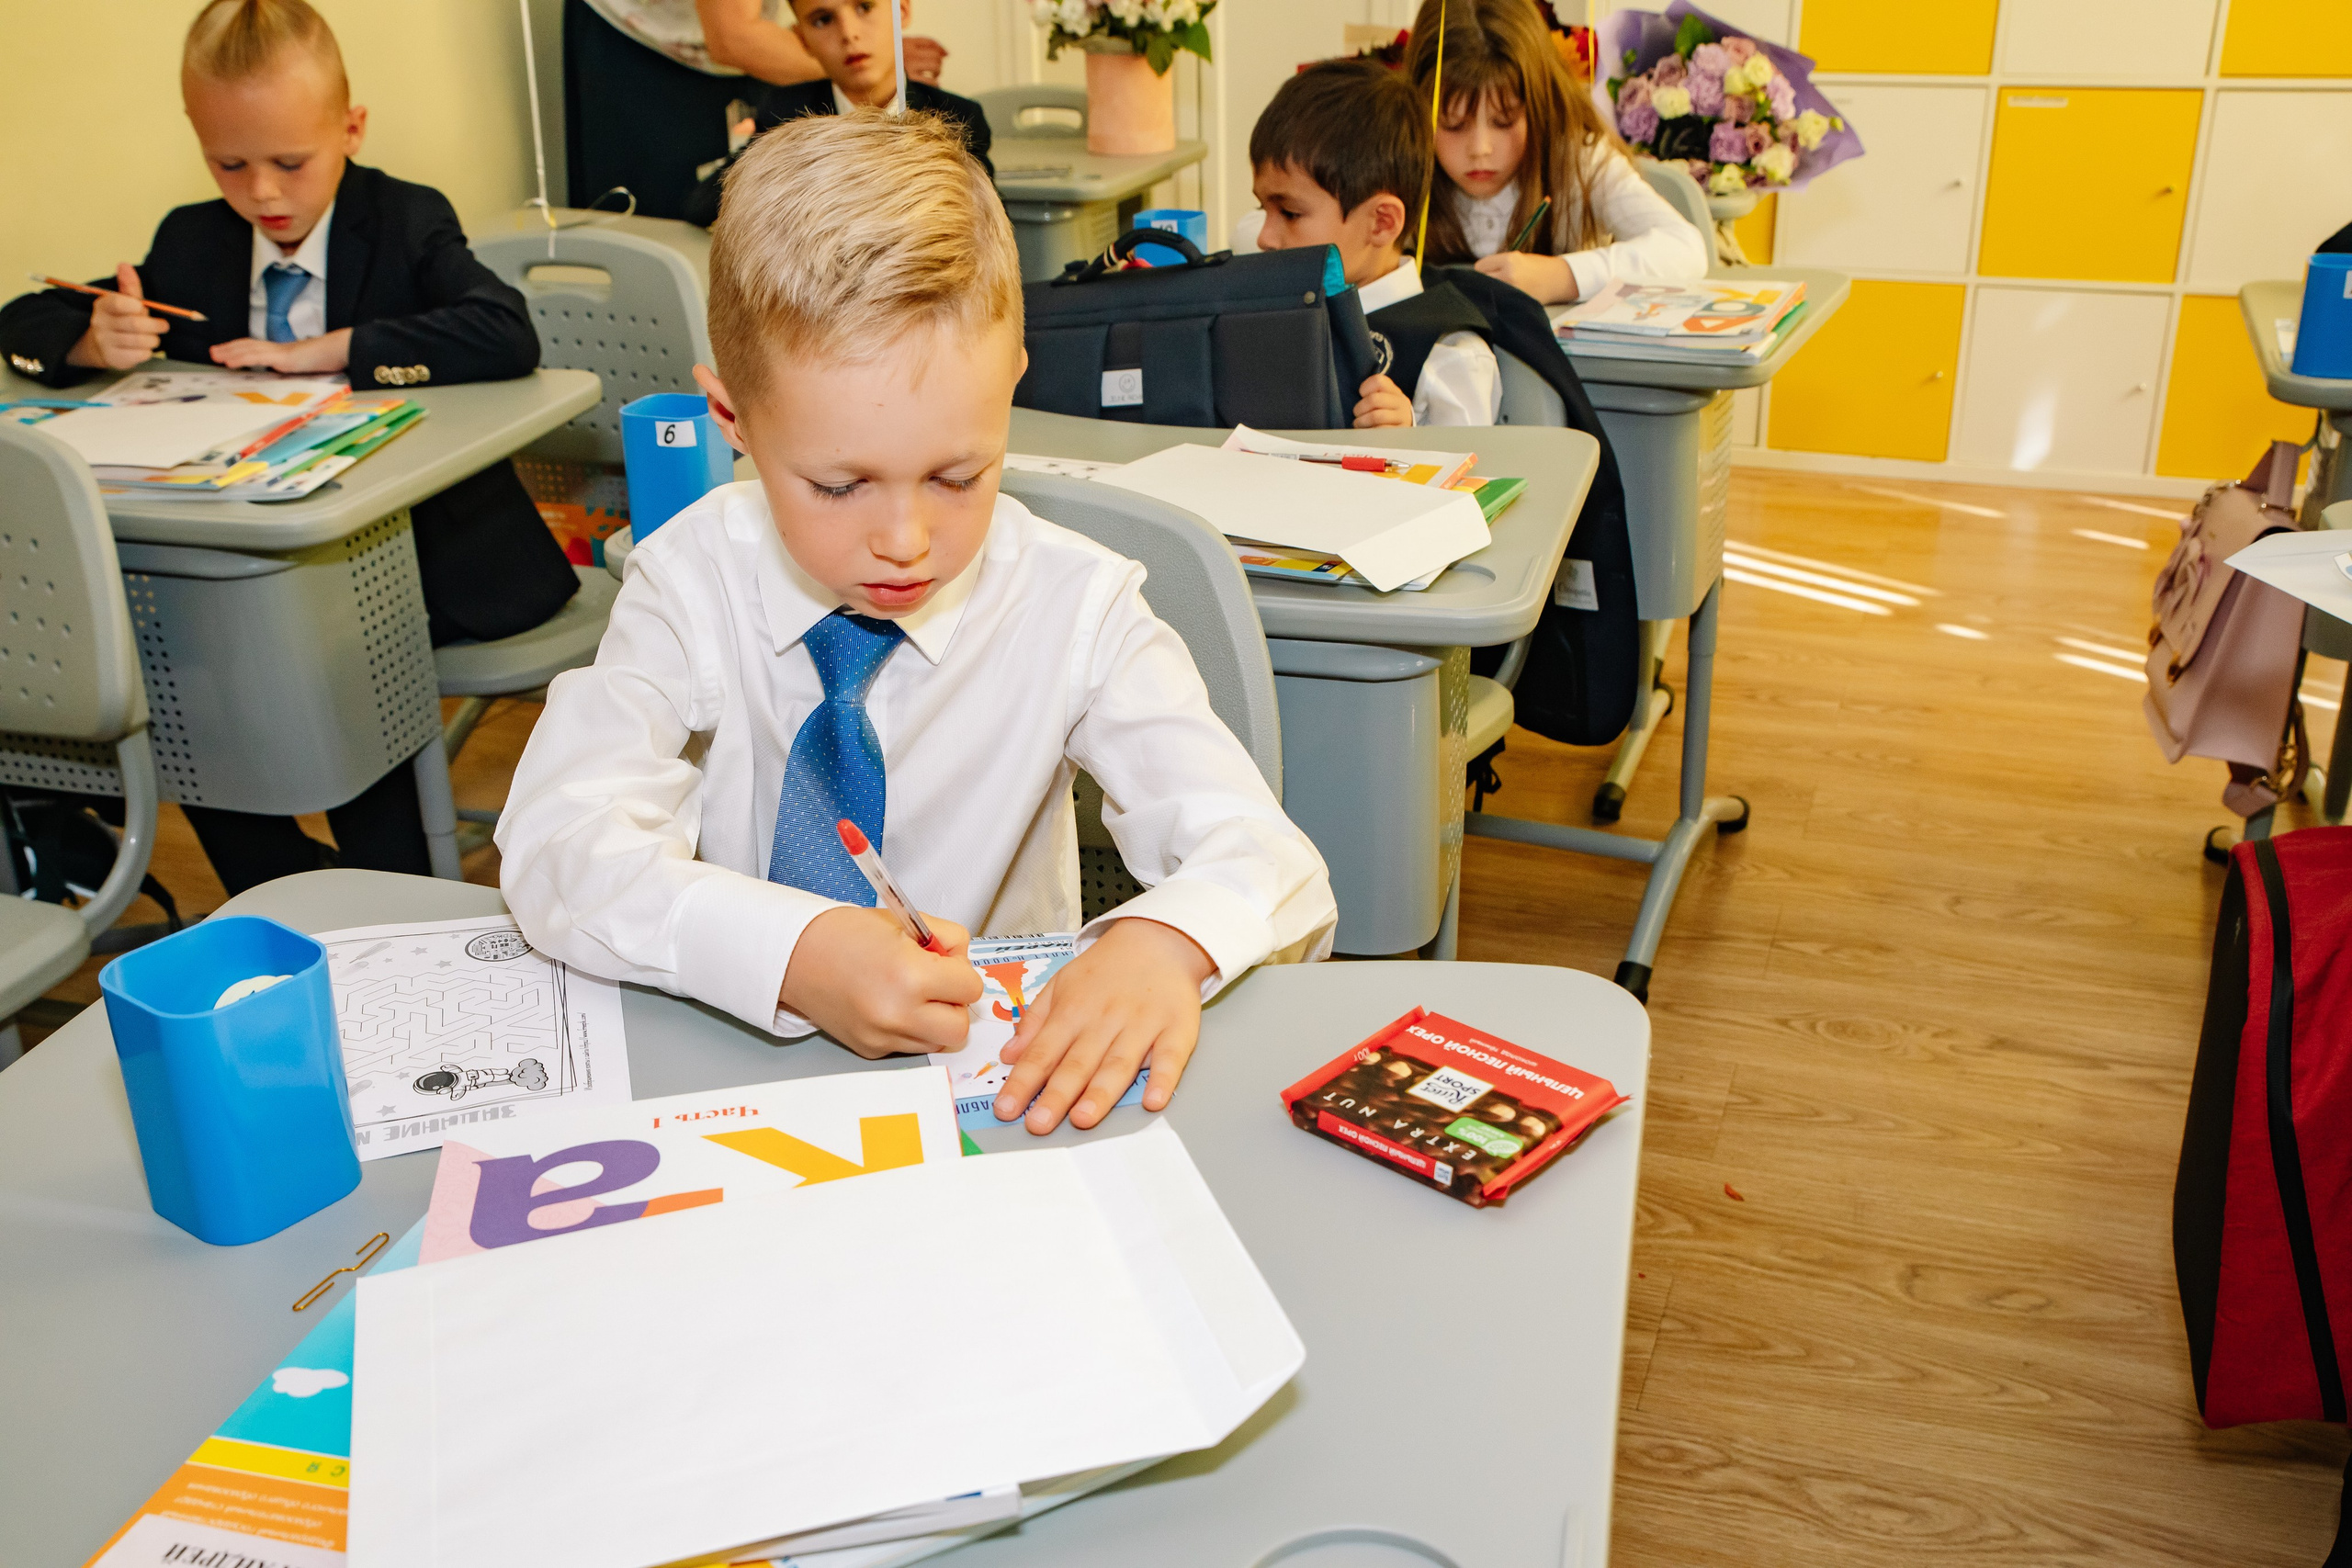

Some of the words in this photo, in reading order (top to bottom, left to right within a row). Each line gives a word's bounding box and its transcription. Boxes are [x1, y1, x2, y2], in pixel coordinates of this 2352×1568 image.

[663, 423, 675, 445] 6
[1034, 951, 1074, 961] ИЛЕТ
[1406, 1024, 1446, 1045] ОРЕХ
[1443, 1038, 1509, 1069] ЛЕСНОЙ
[1434, 1073, 1483, 1096] SPORT
[1504, 1060, 1585, 1100] ЦЕЛЬНЫЙ
[674, 1105, 760, 1122] Часть
[1322, 1091, 1377, 1118] NUT
[383, 1104, 517, 1142] ЗАДАНИЕ
[652, 1117, 662, 1130] 1
[1338, 1124, 1358, 1139] ОРЕХ
[1393, 1119, 1478, 1161] EXTRA
